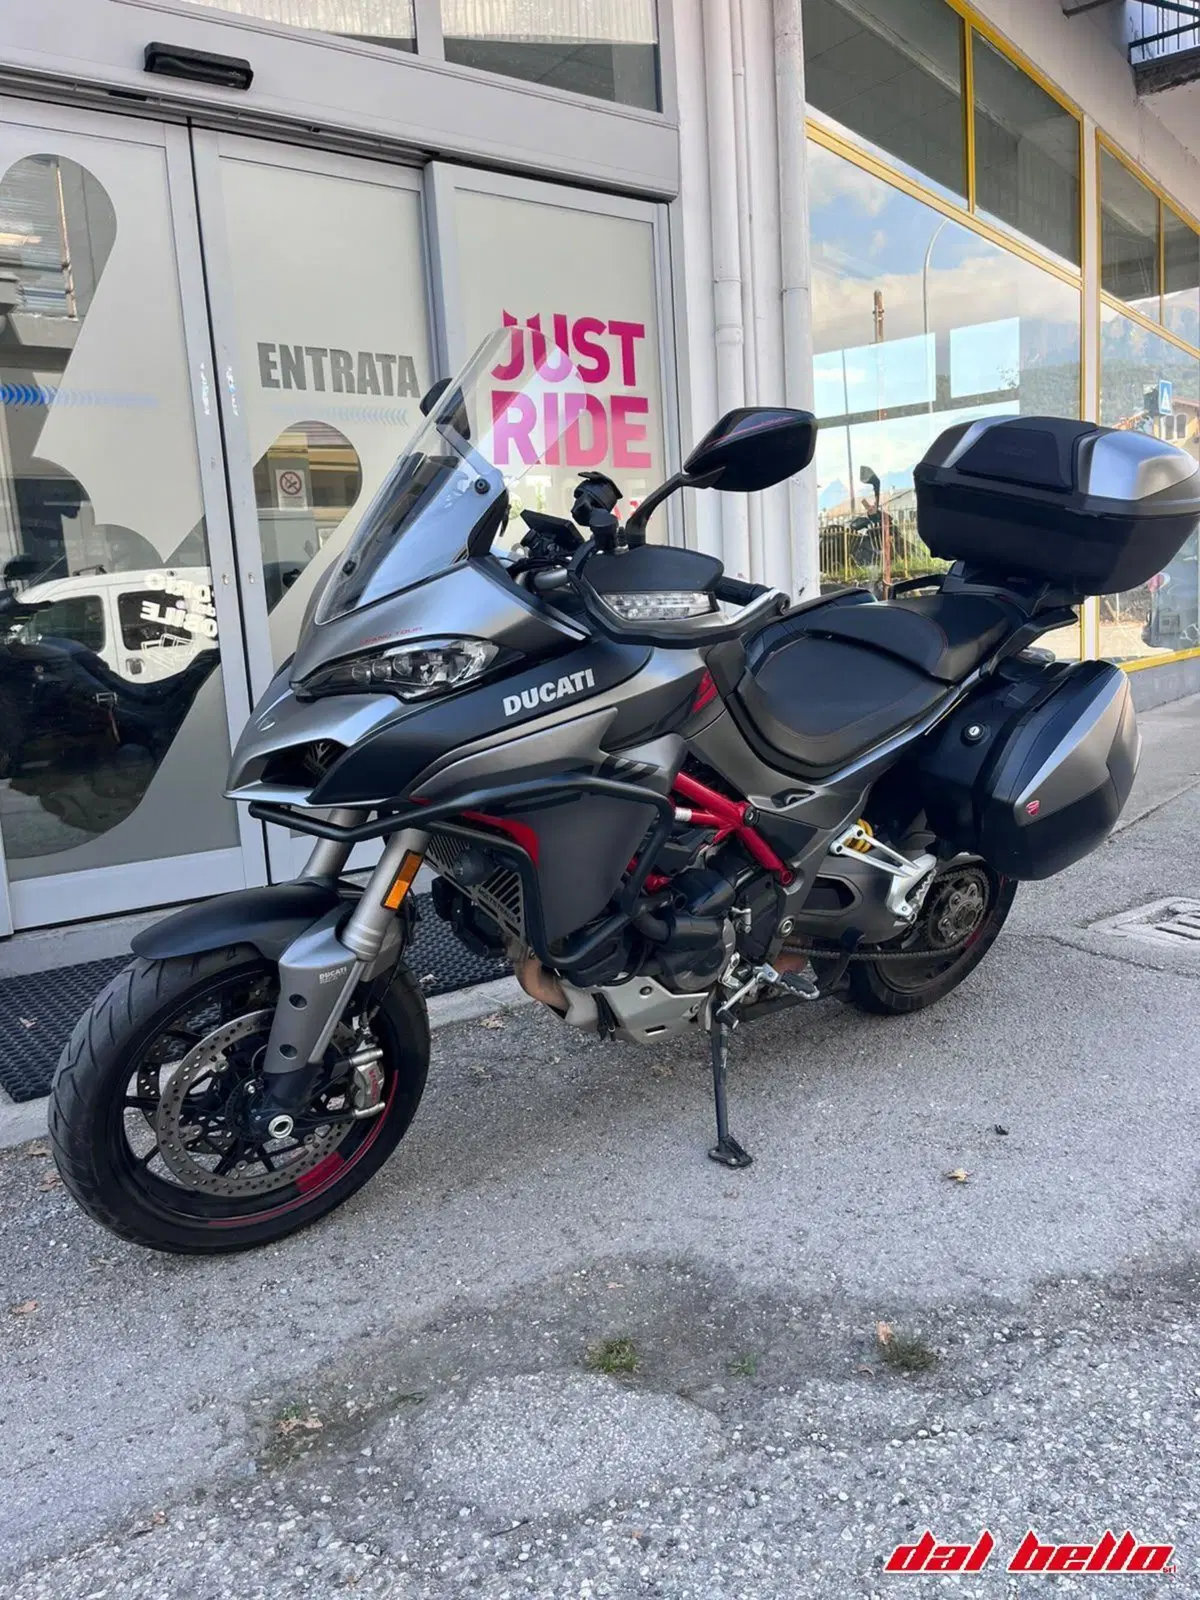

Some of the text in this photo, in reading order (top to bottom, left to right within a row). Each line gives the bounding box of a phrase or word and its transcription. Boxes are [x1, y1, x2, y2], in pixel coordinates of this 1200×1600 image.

[257, 342, 421, 399] ENTRATA
[490, 308, 645, 387] JUST
[491, 390, 652, 469] RIDE
[502, 668, 596, 717] DUCATI
[319, 965, 347, 980] DUCATI
